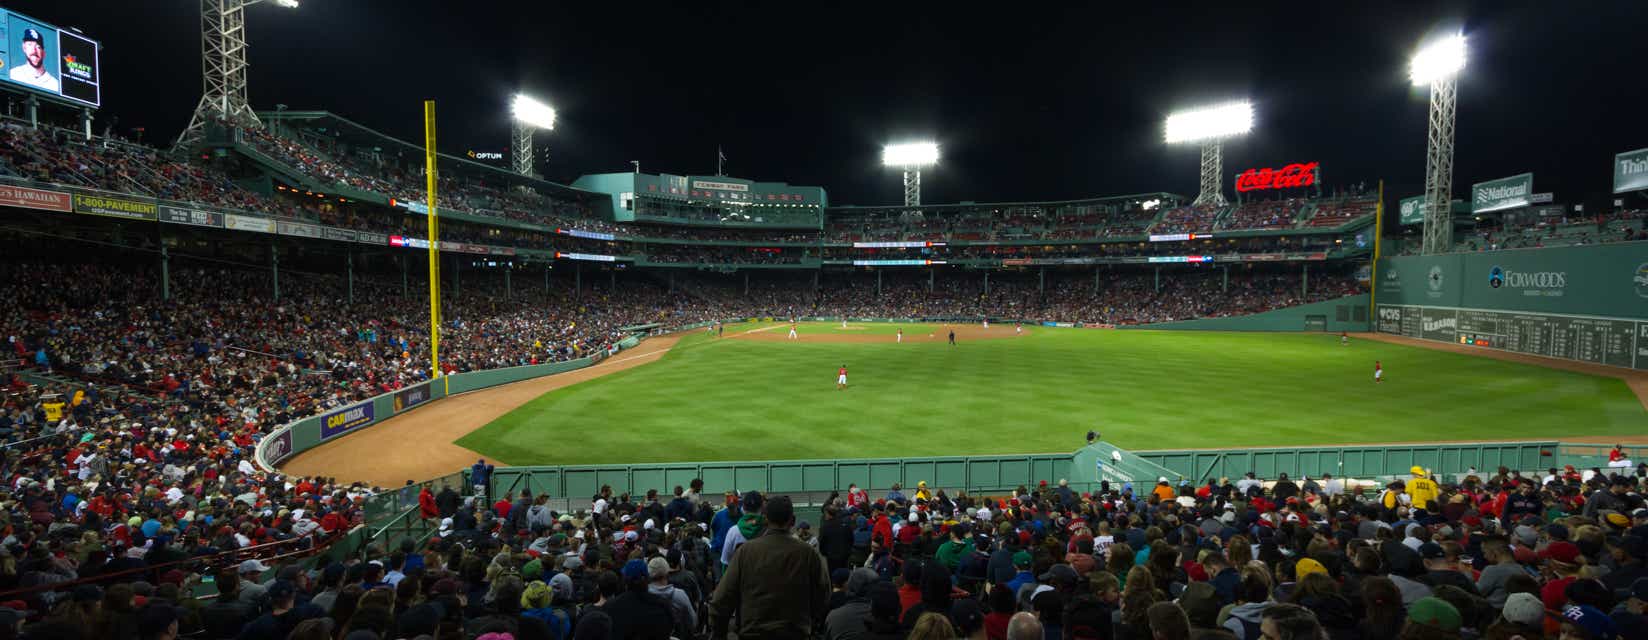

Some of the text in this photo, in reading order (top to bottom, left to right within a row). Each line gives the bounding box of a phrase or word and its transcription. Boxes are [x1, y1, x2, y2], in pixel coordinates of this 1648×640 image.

[1620, 155, 1648, 175] Thin
[15, 189, 60, 203] HAWAIIAN
[1487, 181, 1528, 200] National
[76, 197, 155, 214] 1-800-PAVEMENT
[1386, 309, 1400, 320] CVS
